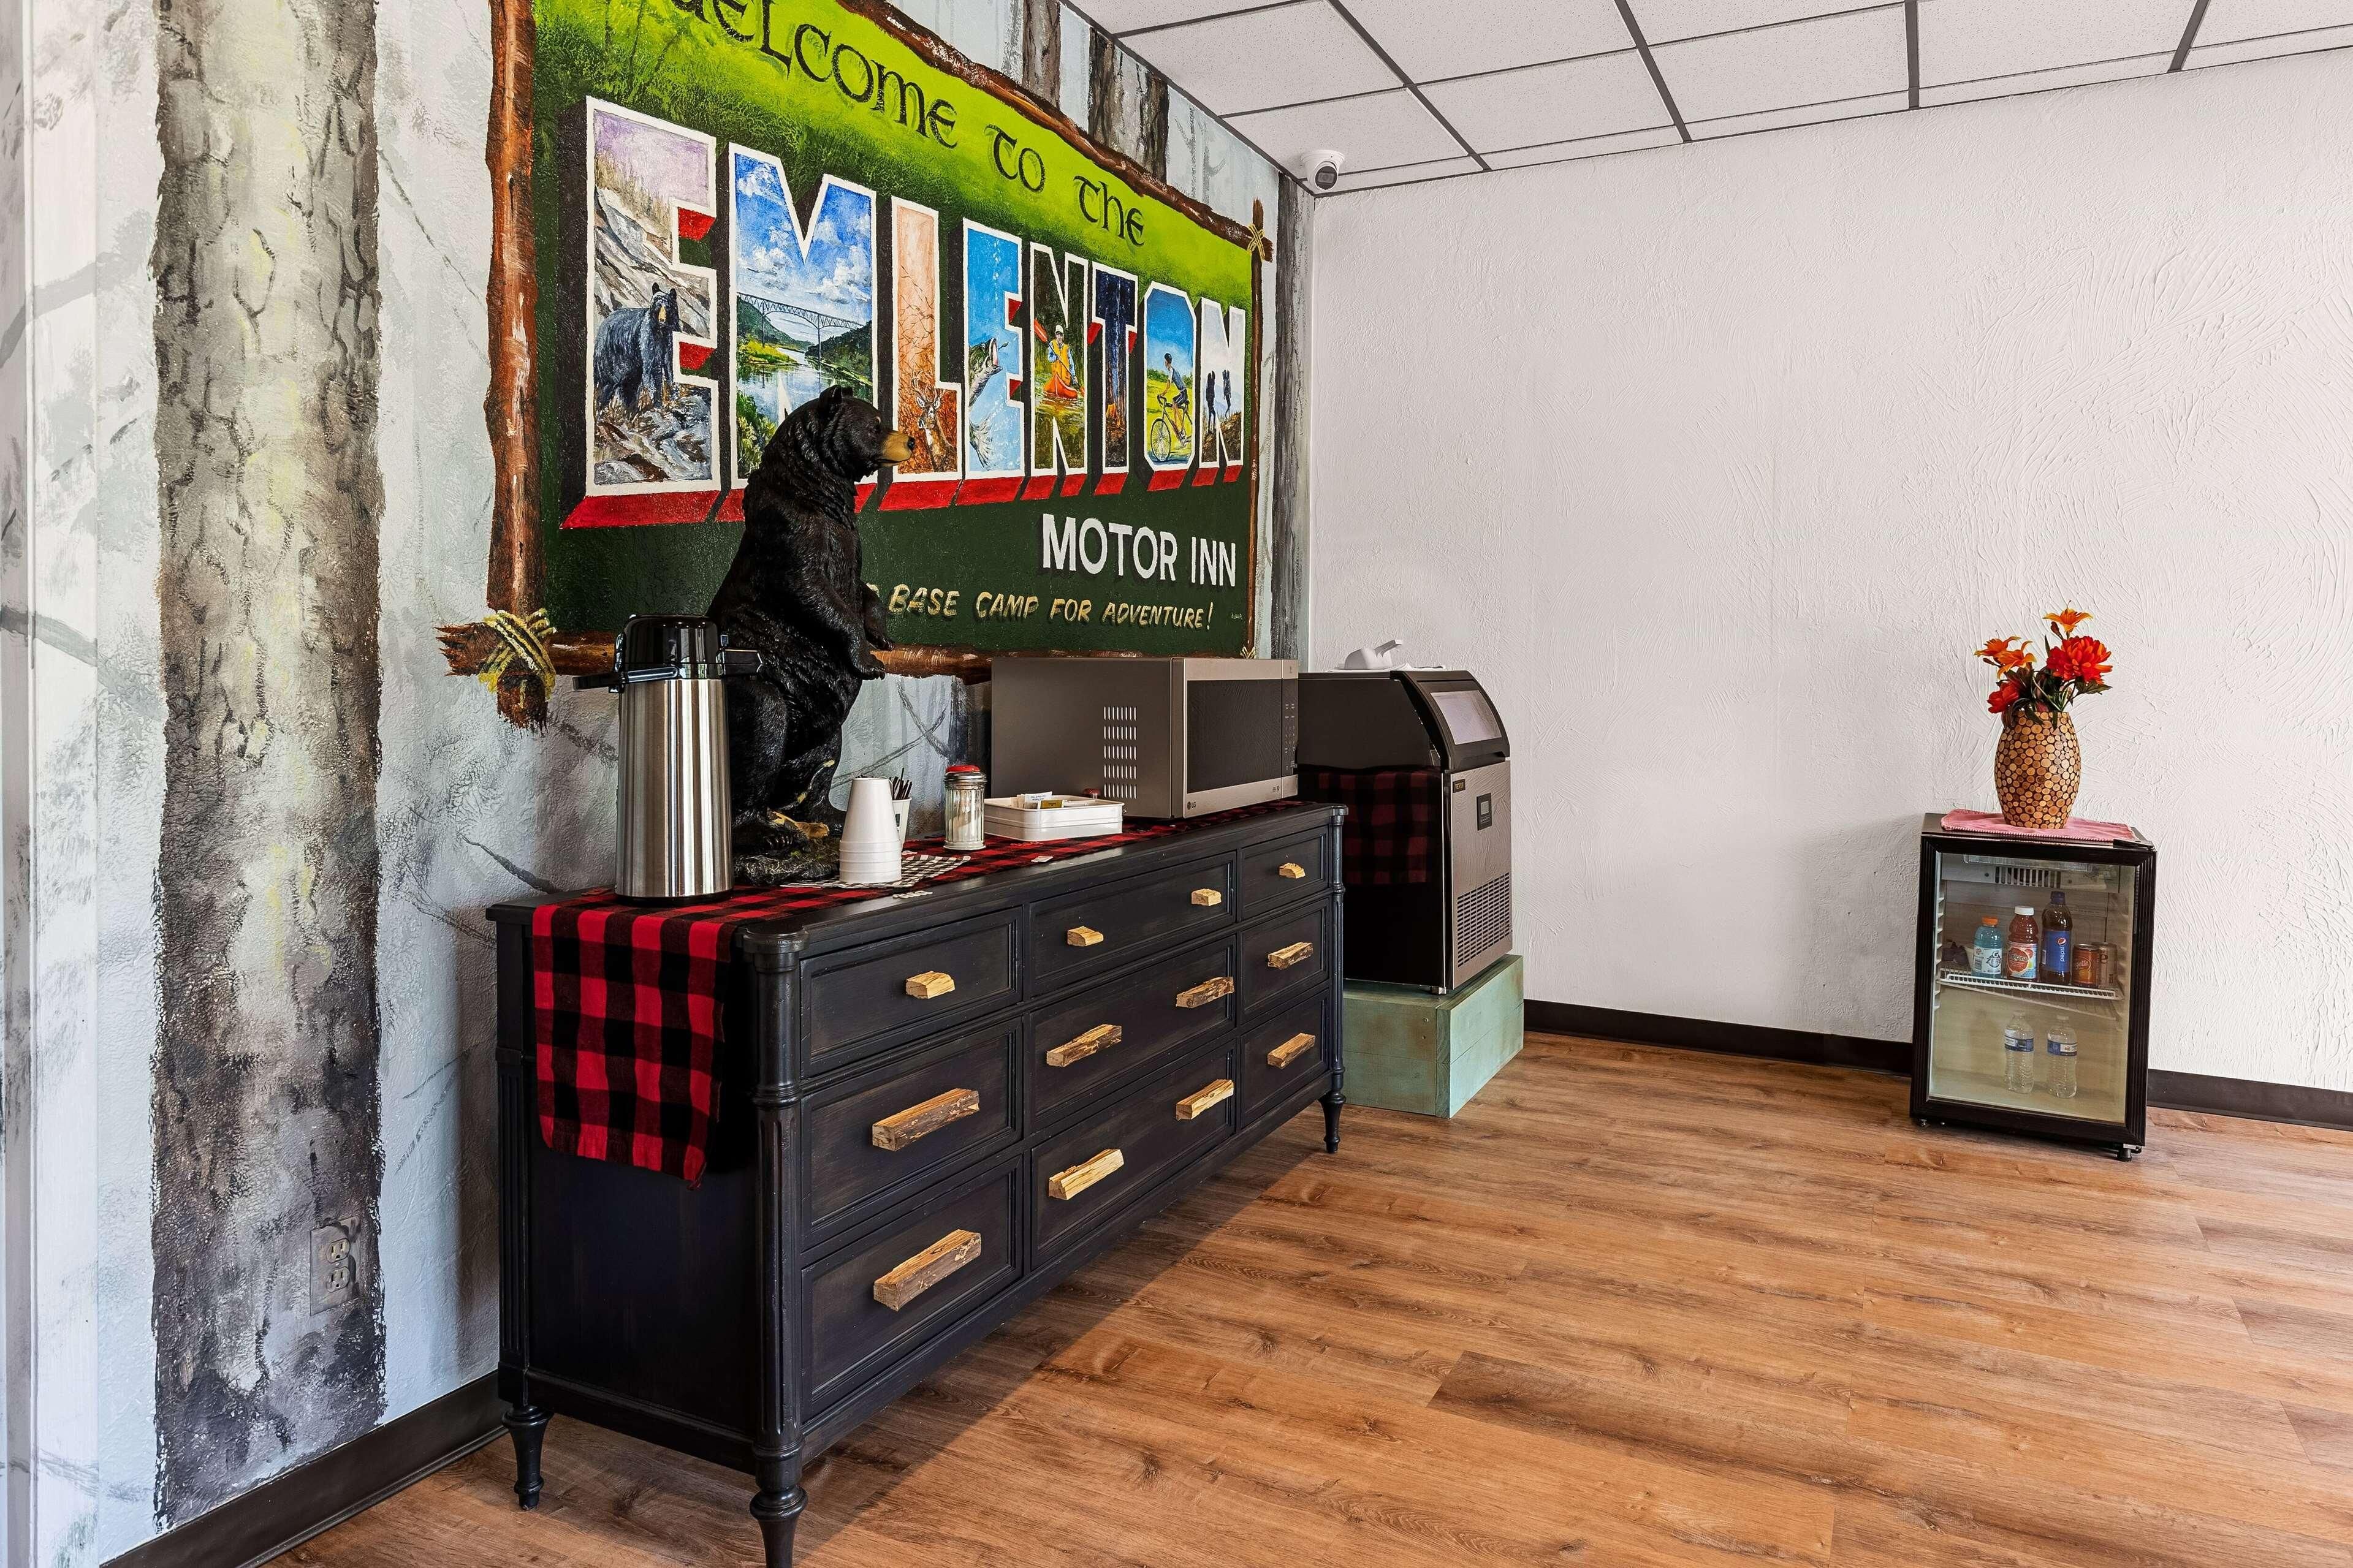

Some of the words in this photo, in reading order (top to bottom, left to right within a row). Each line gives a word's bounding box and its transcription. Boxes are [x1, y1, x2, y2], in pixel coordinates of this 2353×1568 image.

[671, 0, 957, 149] ELCOME
[586, 95, 1247, 496] EMLENTON
[1043, 513, 1177, 581] MOTOR
[1191, 536, 1236, 587] INN
[889, 583, 960, 616] BASE
[976, 591, 1040, 619] CAMP
[1050, 598, 1092, 623] FOR
[1103, 602, 1214, 631] ADVENTURE!
